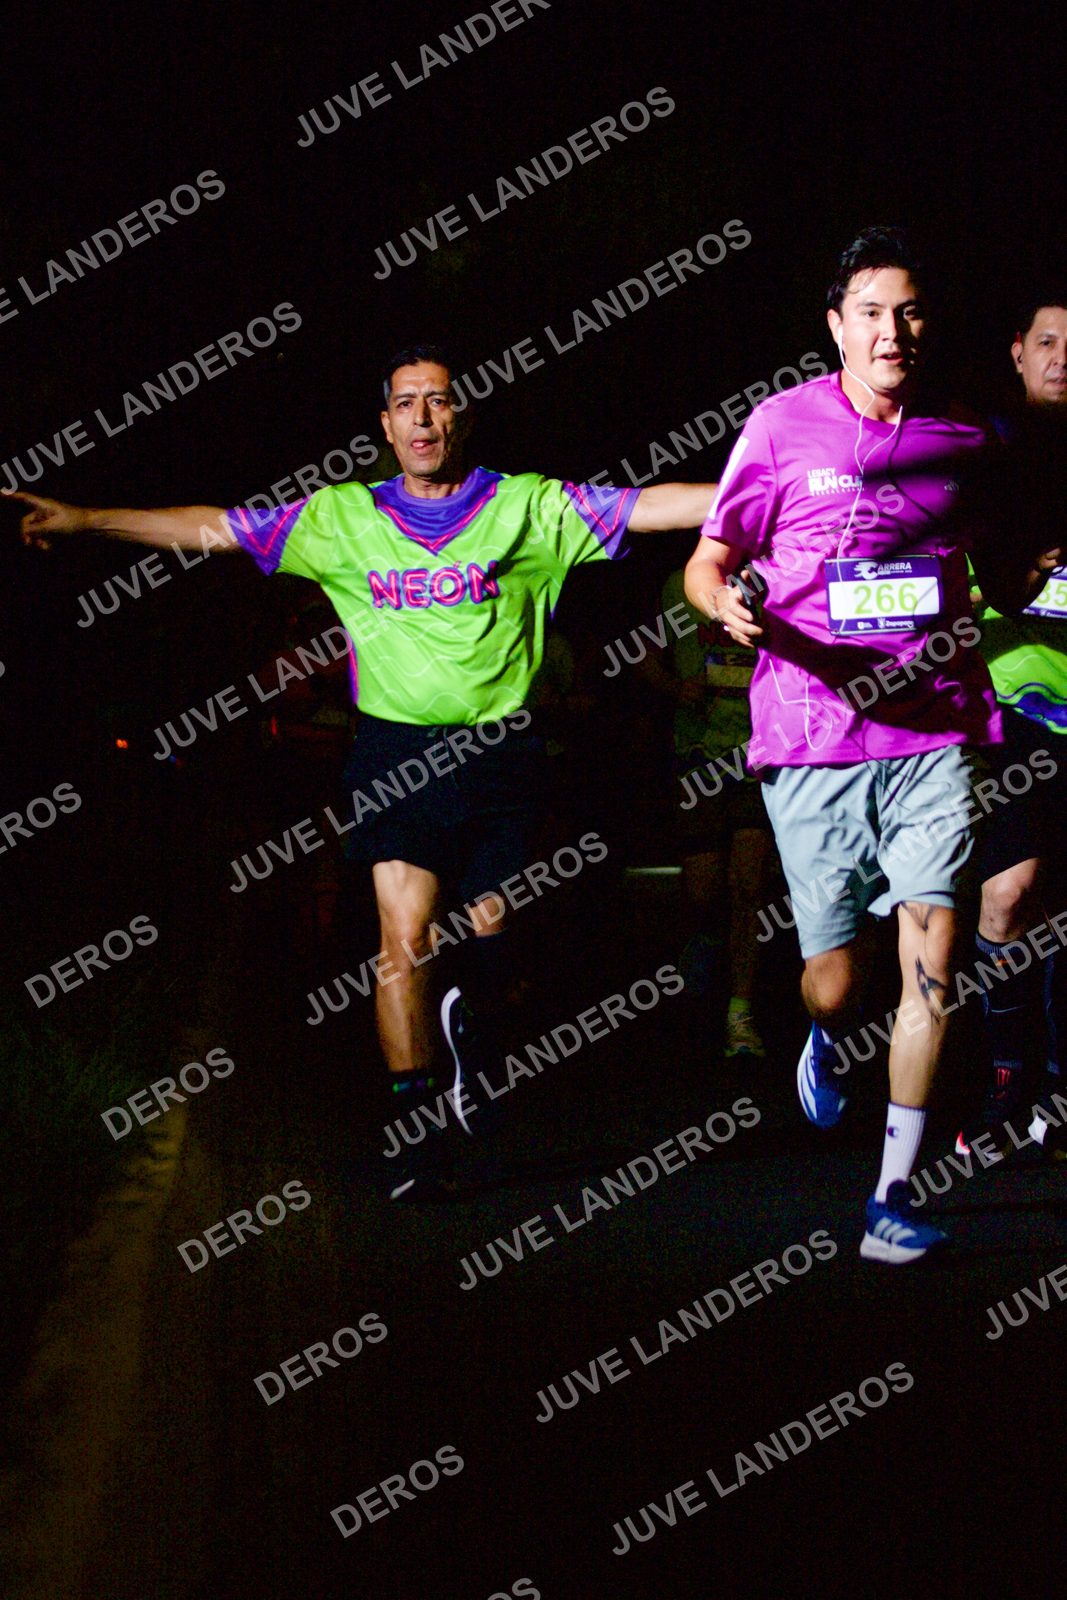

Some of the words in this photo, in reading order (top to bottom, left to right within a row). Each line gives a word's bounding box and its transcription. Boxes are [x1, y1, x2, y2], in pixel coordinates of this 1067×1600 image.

[807, 467, 836, 479] LEGACY
[808, 475, 838, 492] RUN
[853, 582, 918, 615] 266
